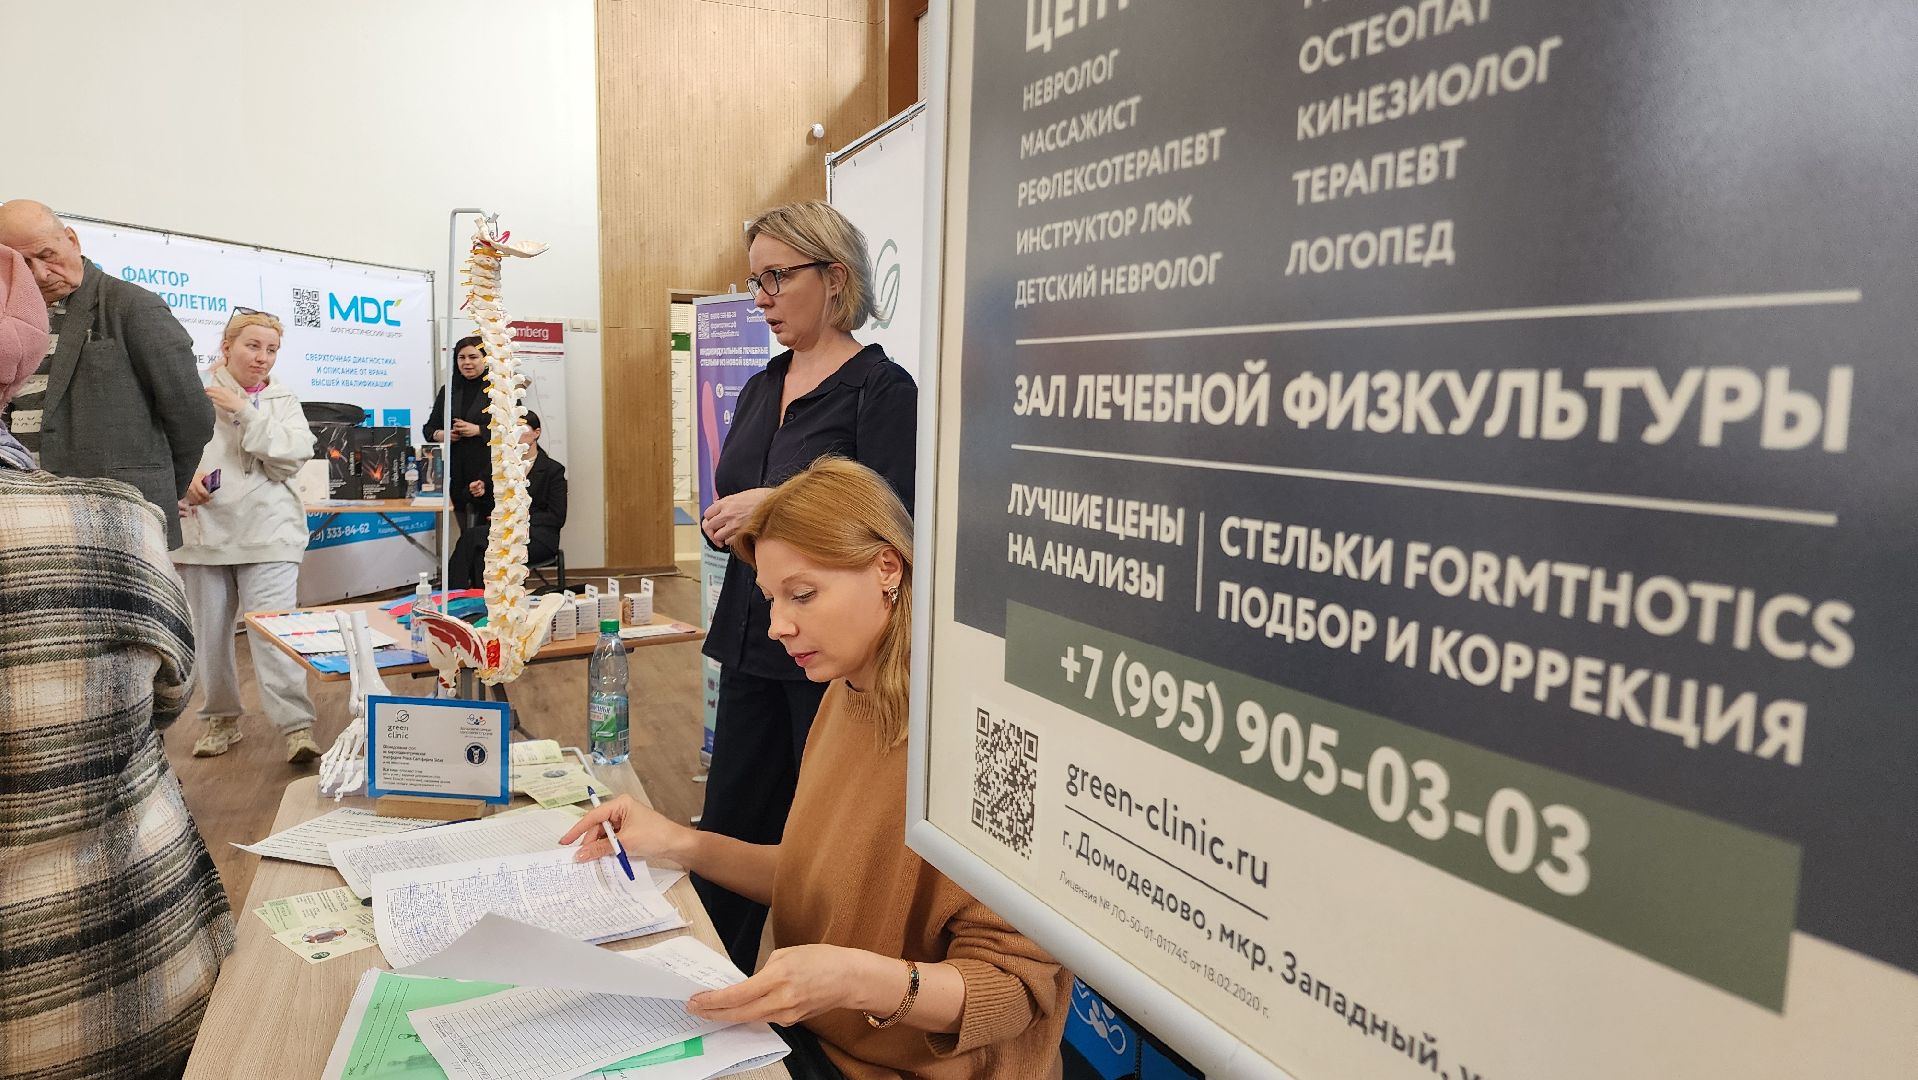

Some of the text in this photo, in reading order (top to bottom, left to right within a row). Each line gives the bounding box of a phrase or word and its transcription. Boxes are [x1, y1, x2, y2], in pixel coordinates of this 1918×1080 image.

[1023, 49, 1120, 111] НЕВРОЛОГ
[1297, 36, 1563, 141] КИНЕЗИОЛОГ
[1020, 96, 1143, 160] МАССАЖИСТ
[1018, 128, 1226, 208] РЕФЛЕКСОТЕРАПЕВТ
[1292, 138, 1467, 206] ТЕРАПЕВТ
[1016, 196, 1193, 255] ИНСТРУКТОР ЛФК
[1285, 220, 1455, 277] ЛОГОПЕД
[121, 265, 190, 288] ФАКТОР
[1015, 252, 1222, 309] ДЕТСКИЙ НЕВРОЛОГ
[328, 291, 402, 327] MDC
[305, 353, 397, 366] СВЕРХТОЧНАЯ ДИАГНОСТИКА
[311, 378, 340, 387] ВЫСШЕЙ
[323, 367, 358, 376] ОПИСАНИЕ
[360, 368, 367, 376] ОТ
[368, 368, 388, 376] ВРАЧА
[1013, 359, 1854, 454] ЗАЛ ЛЕЧЕБНОЙ ФИЗКУЛЬТУРЫ
[327, 523, 370, 540] 333-84-62
[1008, 483, 1185, 546] ЛУЧШИЕ ЦЕНЫ
[1008, 532, 1165, 602] НА АНАЛИЗЫ
[1219, 515, 1857, 669] СТЕЛЬКИ FORMTHOTICS
[1217, 580, 1808, 766] ПОДБОР И КОРРЕКЦИЯ
[388, 731, 409, 739] clinic
[1060, 644, 1591, 897] +7 (995) 905-03-03
[1065, 761, 1270, 889] green-clinic.ru
[1061, 827, 1073, 851] г.
[1076, 832, 1213, 942] Домодедово,
[1218, 923, 1276, 975] мкр.
[1059, 870, 1098, 904] Лицензия
[1099, 895, 1110, 912] №
[1111, 903, 1188, 965] ЛО-50-01-011745
[1190, 958, 1203, 974] от
[1203, 963, 1261, 1012] 18.02.2020
